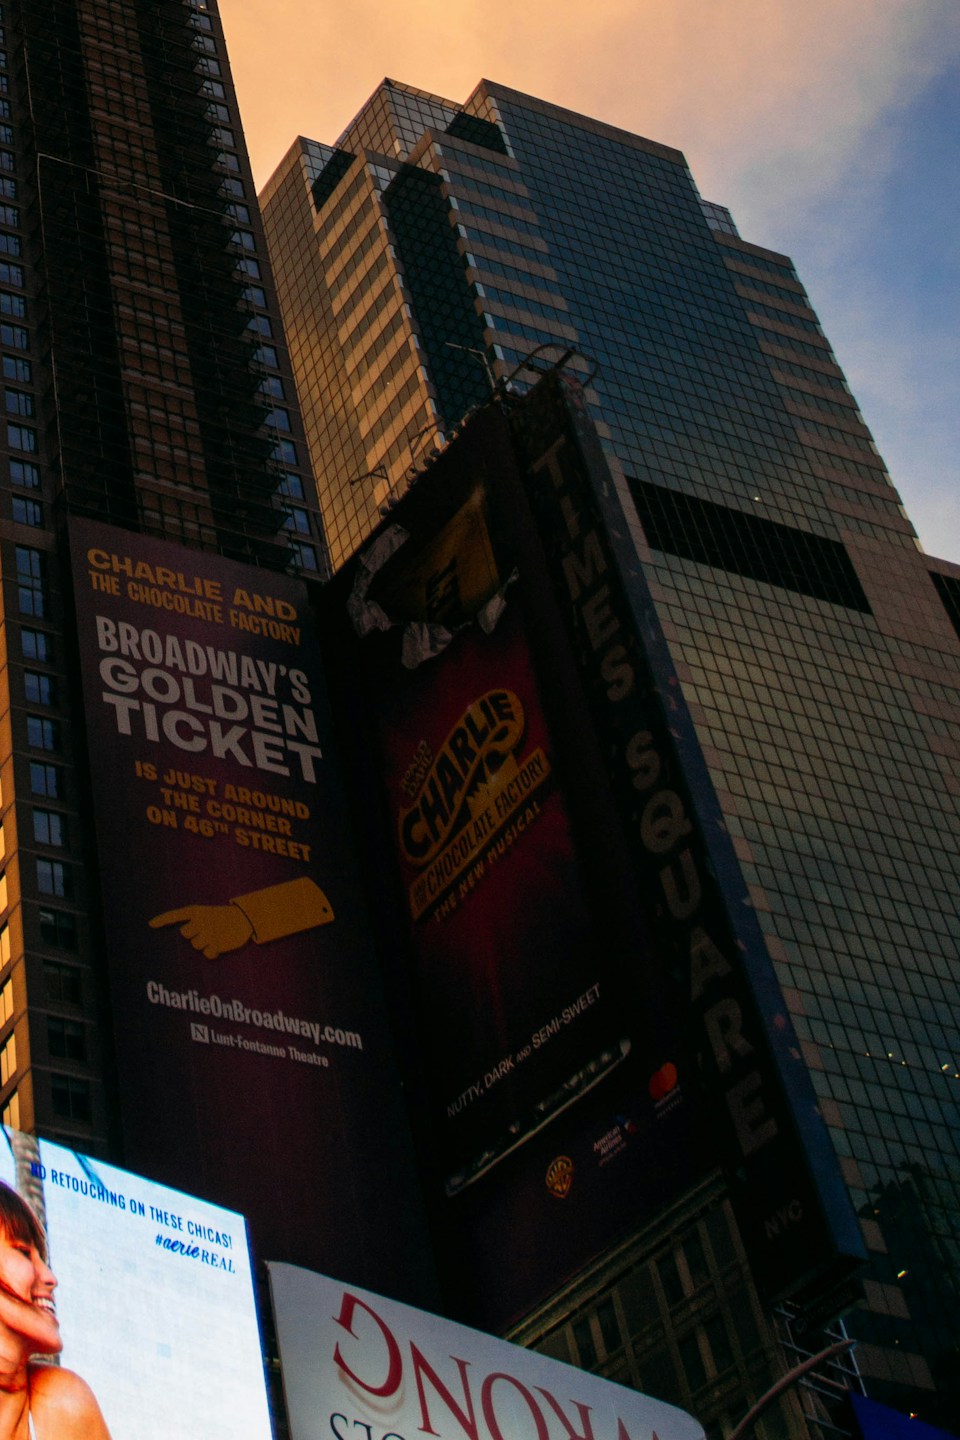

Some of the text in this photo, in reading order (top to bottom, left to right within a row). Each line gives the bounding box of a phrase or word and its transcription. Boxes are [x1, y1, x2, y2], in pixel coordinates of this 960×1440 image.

[86, 548, 299, 622] CHARLIE AND
[88, 569, 302, 647] THE CHOCOLATE FACTORY
[95, 614, 313, 705] BROADWAY'S
[99, 656, 320, 744] GOLDEN
[102, 691, 324, 785] TICKET
[403, 693, 516, 857] CHARLIE
[134, 760, 310, 821] IS JUST AROUND
[146, 804, 313, 863] ON 46TH STREET
[160, 787, 293, 837] THE CORNER
[426, 755, 544, 895] CHOCOLATE FACTORY
[527, 434, 780, 1157] TIMES SQUARE
[434, 800, 543, 922] THE NEW MUSICAL
[146, 980, 363, 1050] CharlieOnBroadway.com
[211, 1029, 286, 1059] Lunt-Fontanne
[288, 1046, 330, 1068] Theatre
[446, 1080, 484, 1118] NUTTY,
[483, 1054, 515, 1089] DARK
[532, 981, 600, 1049] SEMI-SWEET
[31, 1162, 233, 1250] NO RETOUCHING ON THESE CHICAS!
[763, 1200, 803, 1241] NYC
[331, 1291, 660, 1440] ONG
